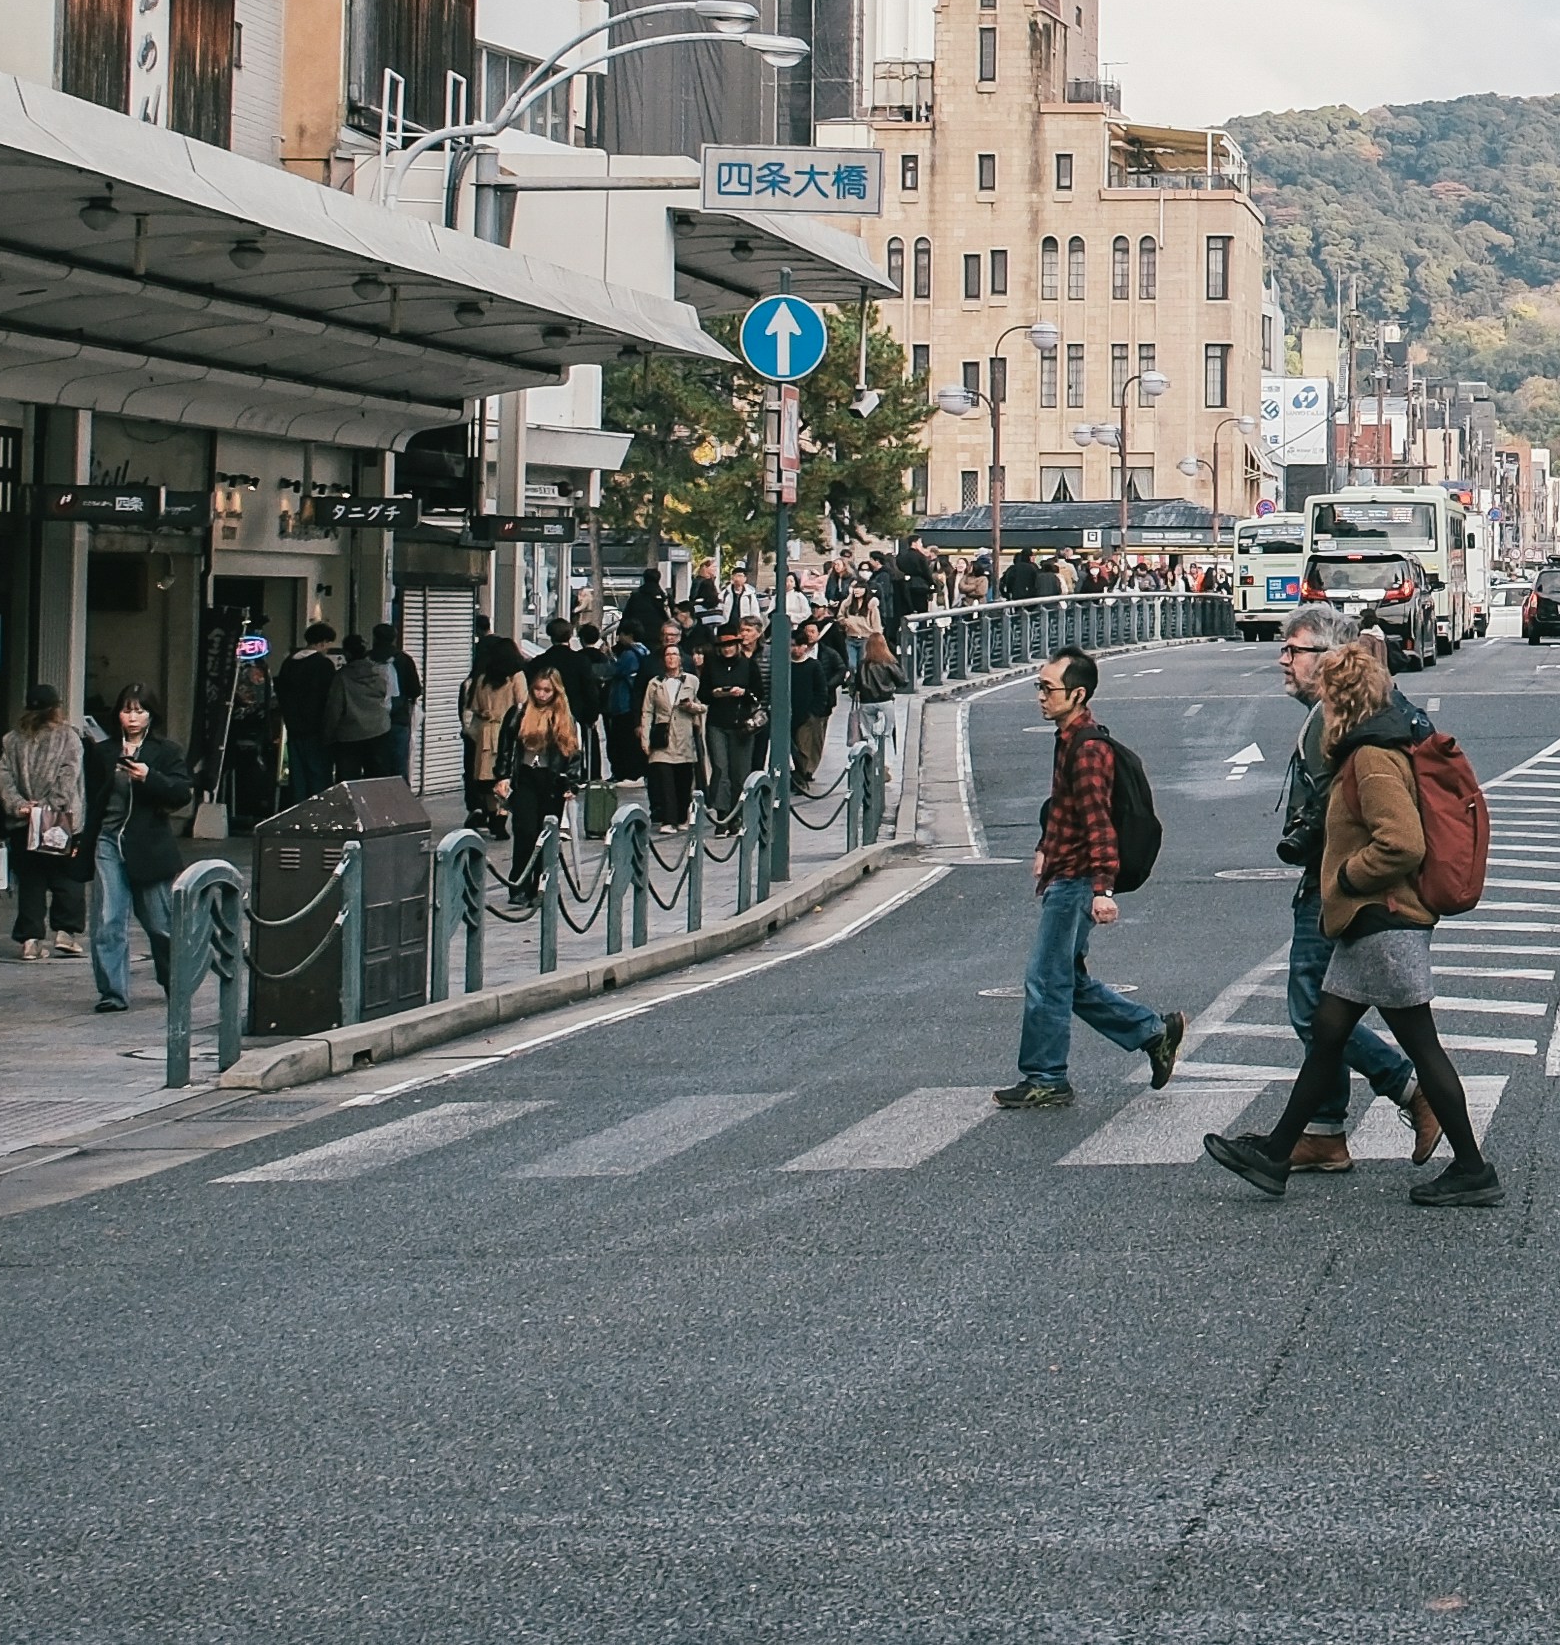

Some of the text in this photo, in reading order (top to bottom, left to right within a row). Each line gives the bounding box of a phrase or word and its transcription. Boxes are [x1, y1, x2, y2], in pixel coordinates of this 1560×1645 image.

[717, 162, 869, 200] 四条大橋
[330, 503, 401, 522] タニグチ
